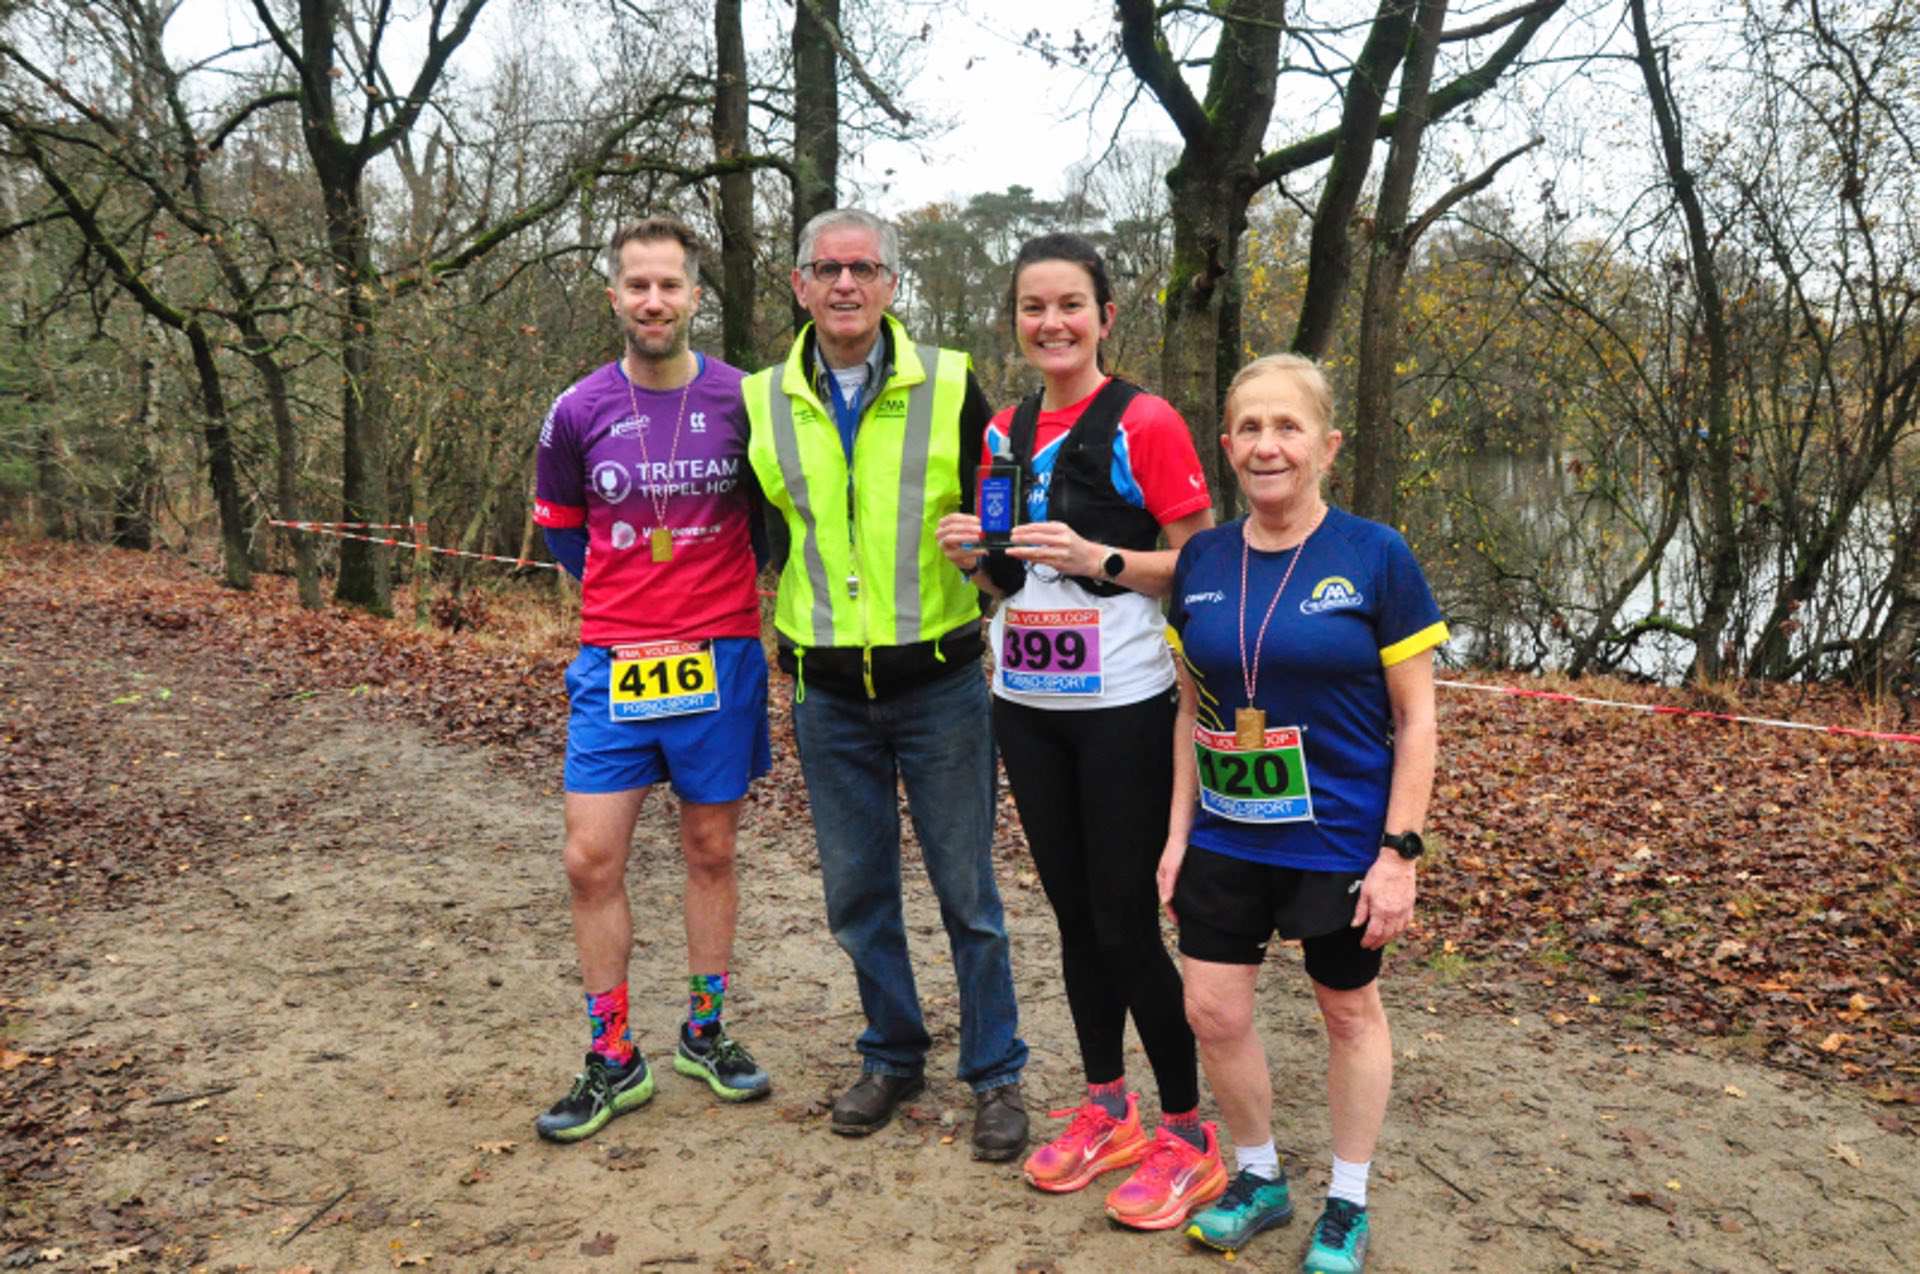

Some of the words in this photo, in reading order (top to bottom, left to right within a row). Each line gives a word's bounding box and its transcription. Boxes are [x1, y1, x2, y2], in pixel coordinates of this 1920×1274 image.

[635, 458, 739, 481] TRITEAM
[640, 481, 701, 498] TRIPEL
[1006, 627, 1086, 670] 399
[618, 657, 704, 697] 416
[1201, 751, 1290, 795] 120
